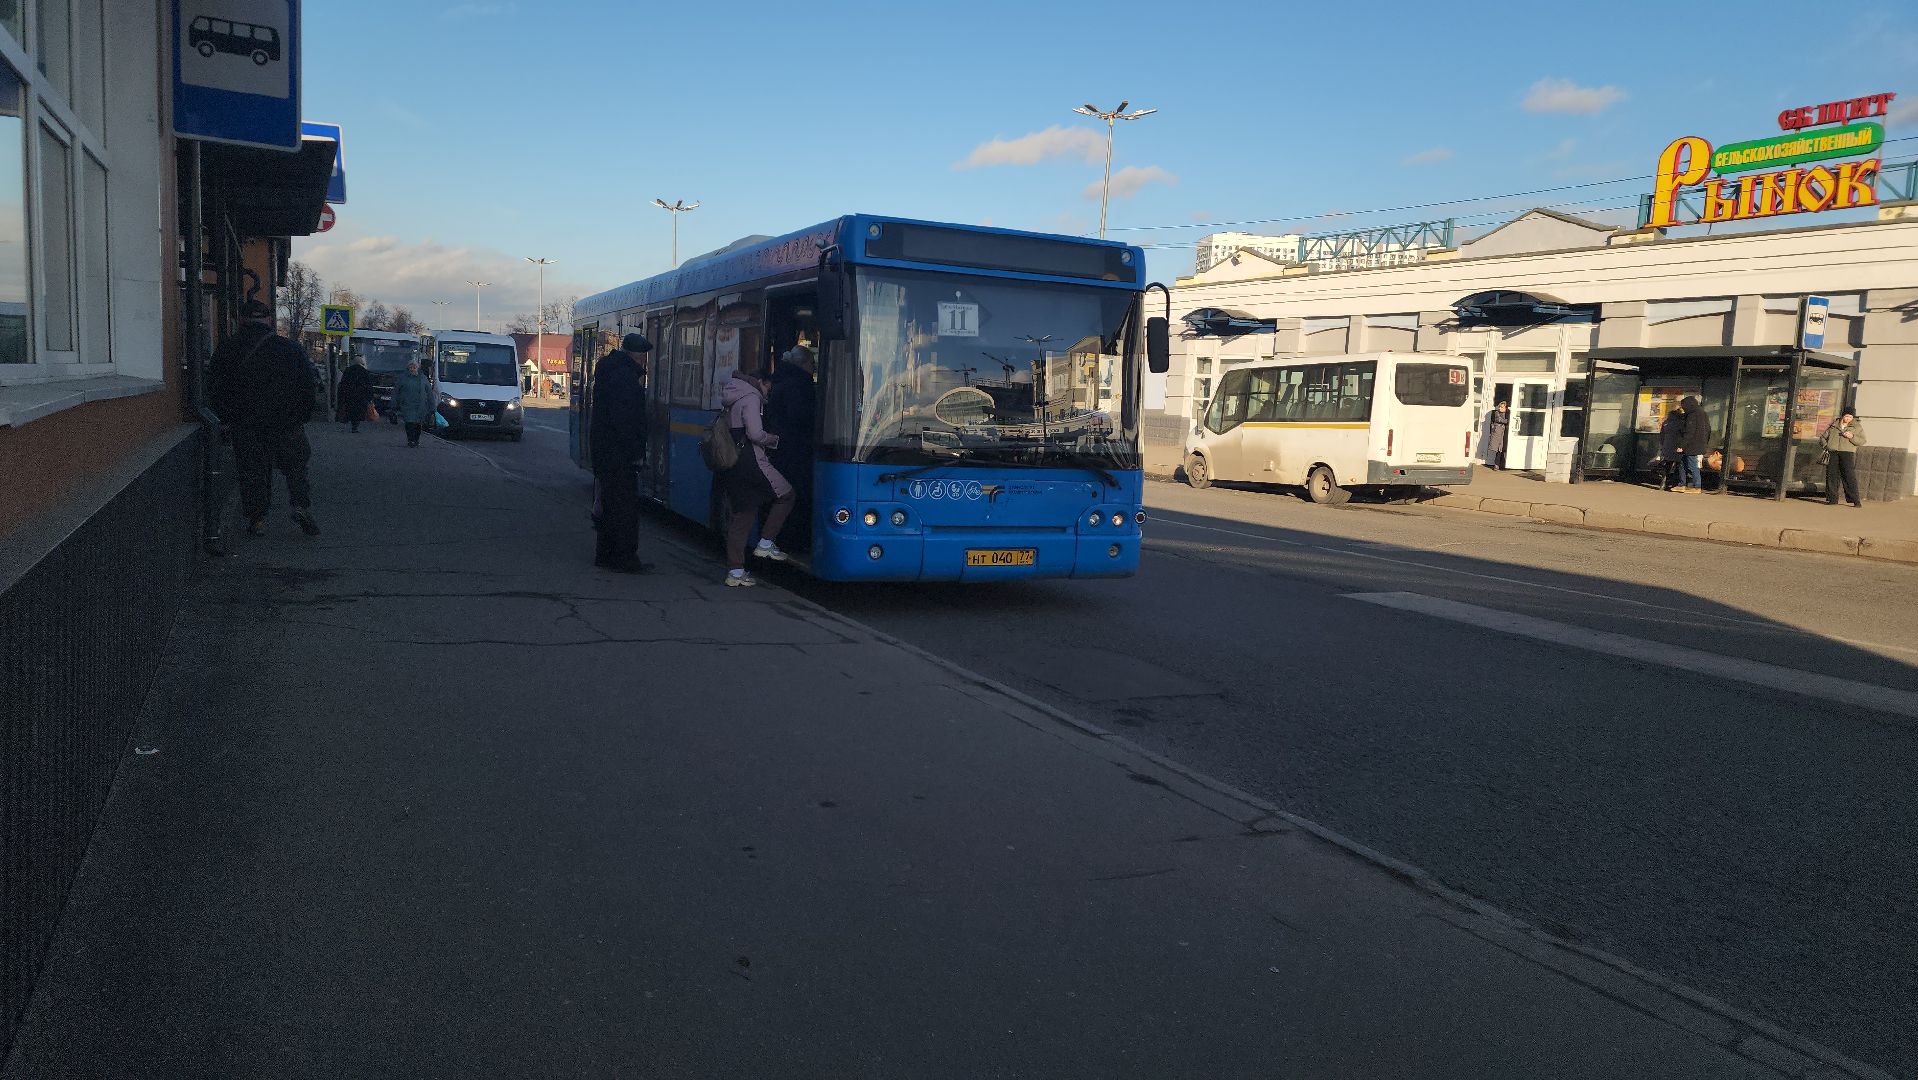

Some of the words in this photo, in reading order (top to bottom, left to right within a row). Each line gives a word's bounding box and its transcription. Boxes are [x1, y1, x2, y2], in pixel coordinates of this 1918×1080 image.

[1714, 126, 1873, 168] СЕЛЬСКОХОЗЯЙСТВЕННЫЙ
[949, 309, 968, 331] 11
[972, 554, 987, 564] НТ
[991, 552, 1013, 564] 040
[1019, 550, 1030, 561] 77
